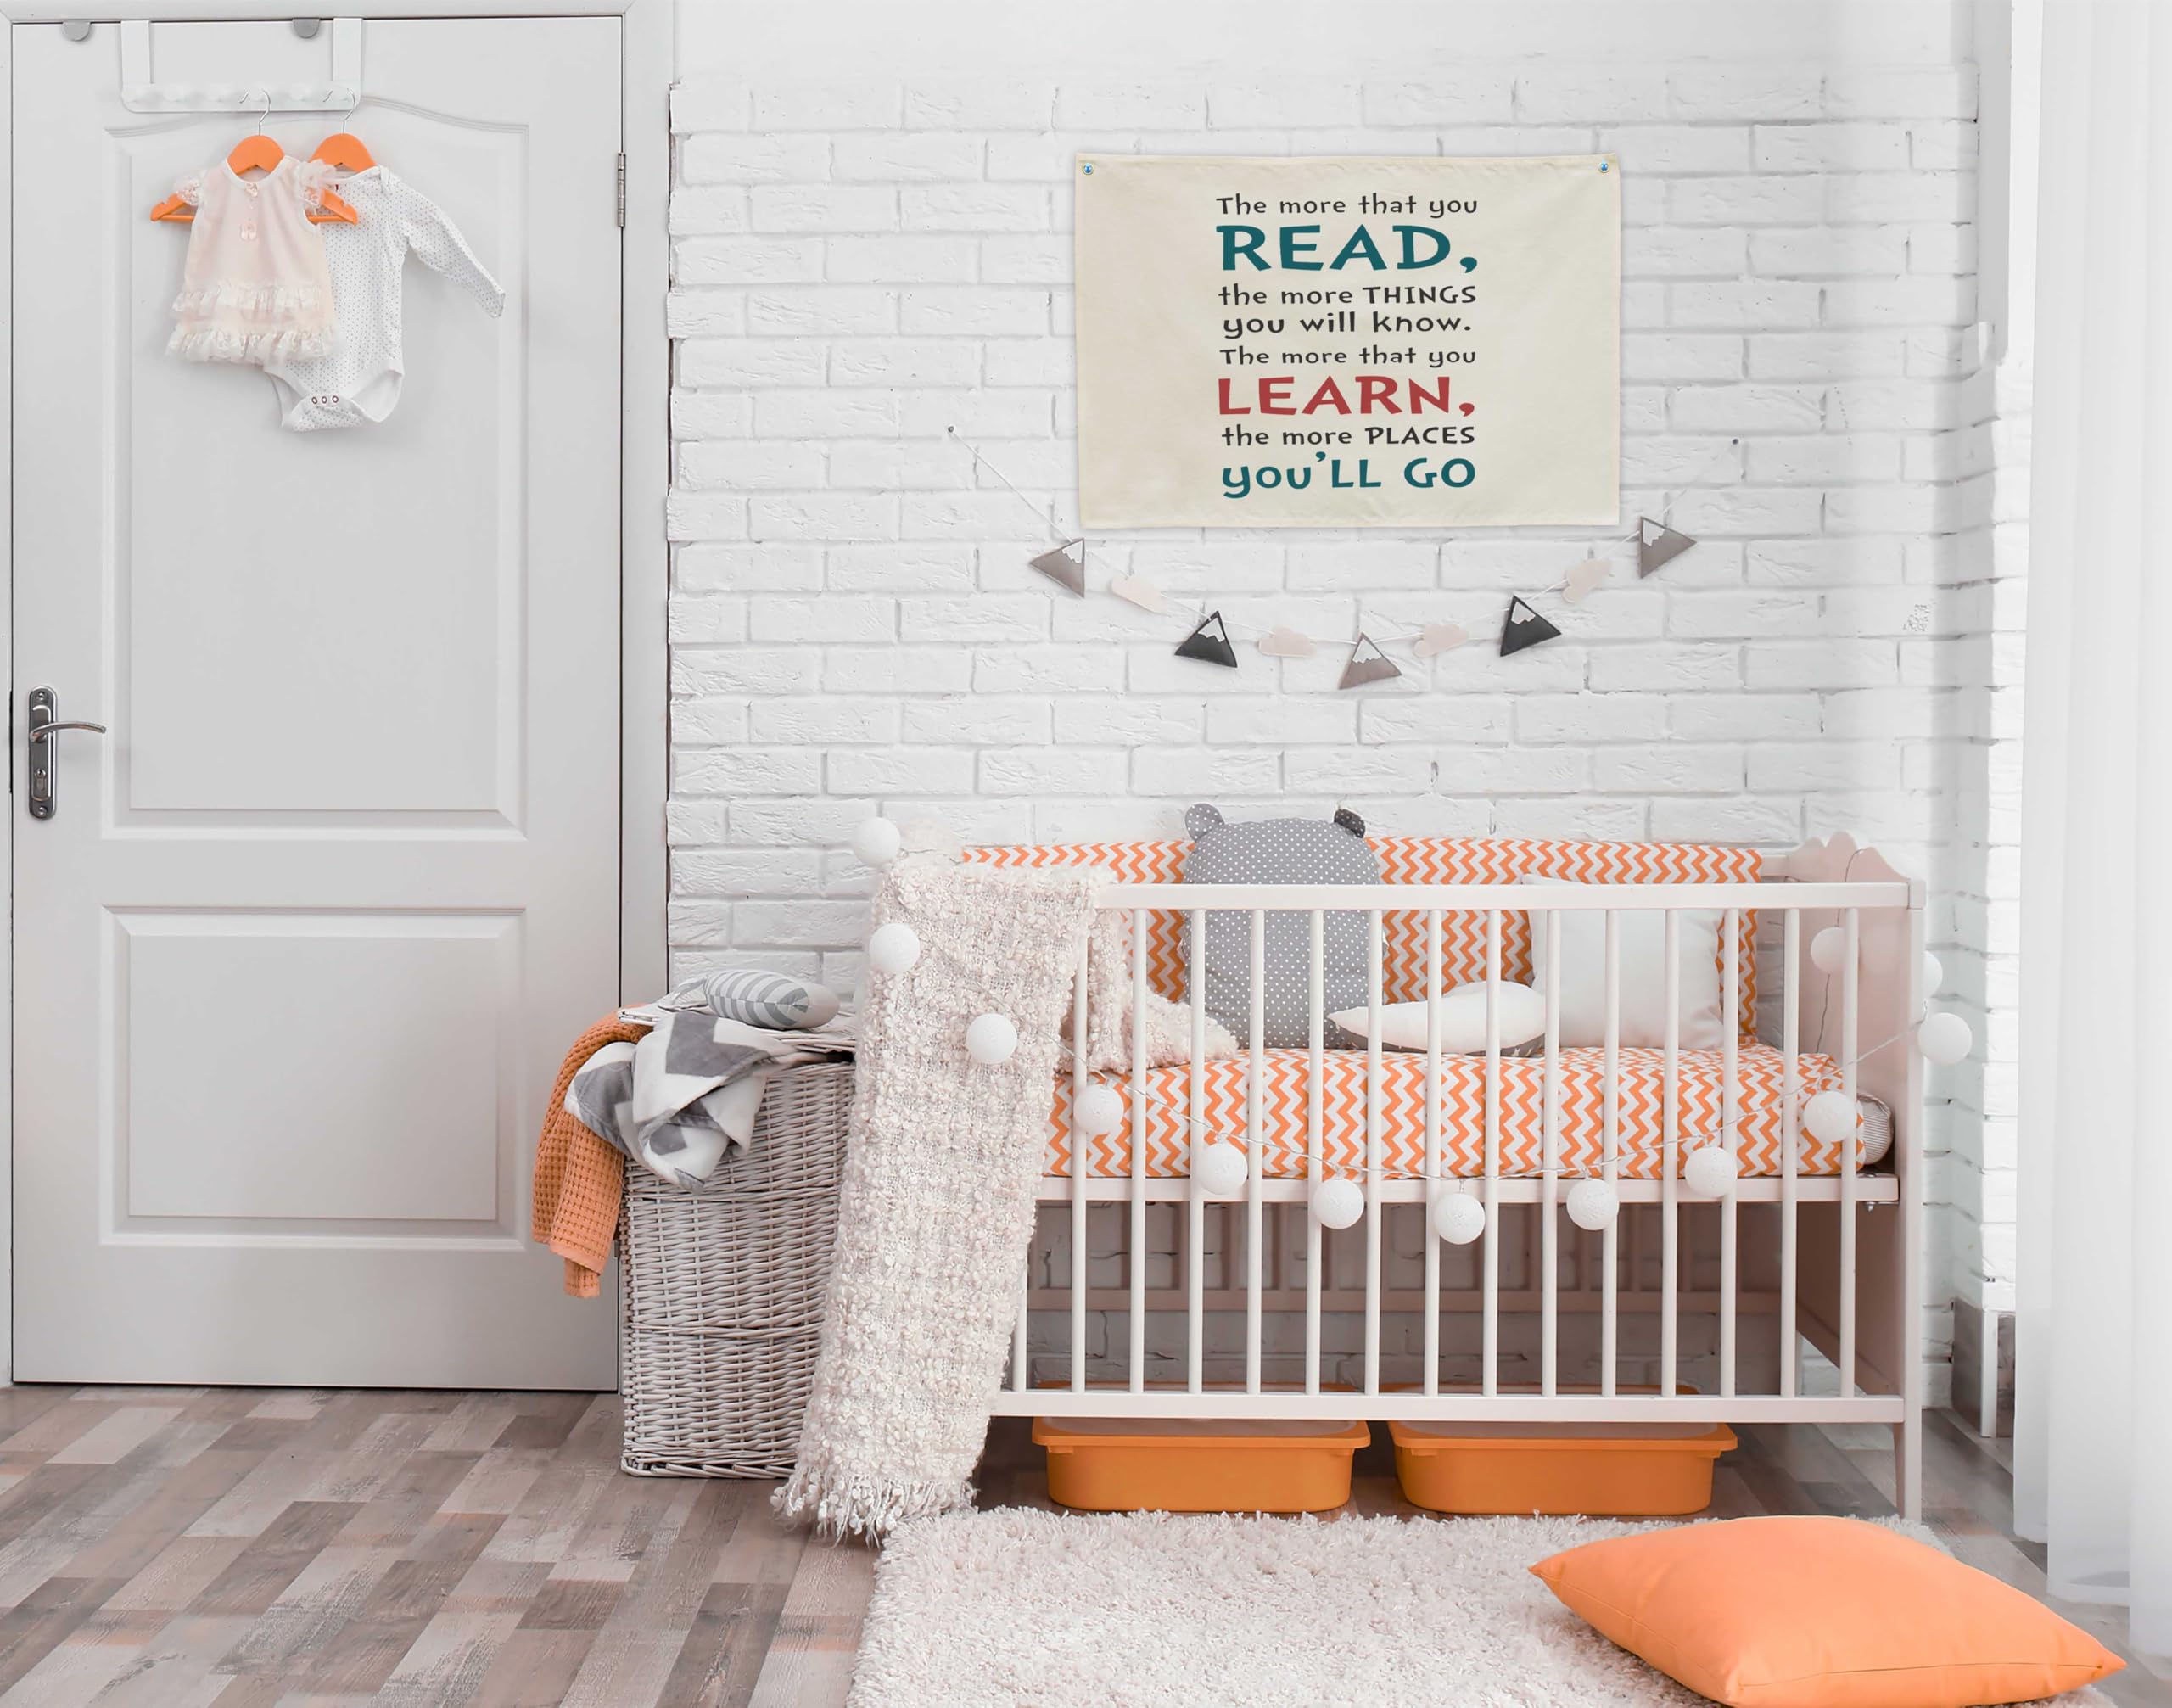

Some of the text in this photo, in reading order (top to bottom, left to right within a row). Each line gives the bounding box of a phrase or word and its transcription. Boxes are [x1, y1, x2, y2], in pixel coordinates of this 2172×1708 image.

[1216, 193, 1478, 219] The more that you
[1215, 223, 1478, 274] READ,
[1218, 283, 1476, 306] the more THINGS
[1223, 311, 1471, 340] you will know.
[1218, 344, 1476, 369] The more that you
[1218, 375, 1475, 417] LEARN,
[1221, 423, 1475, 447] the more PLACES
[1222, 451, 1476, 499] you'LL GO
